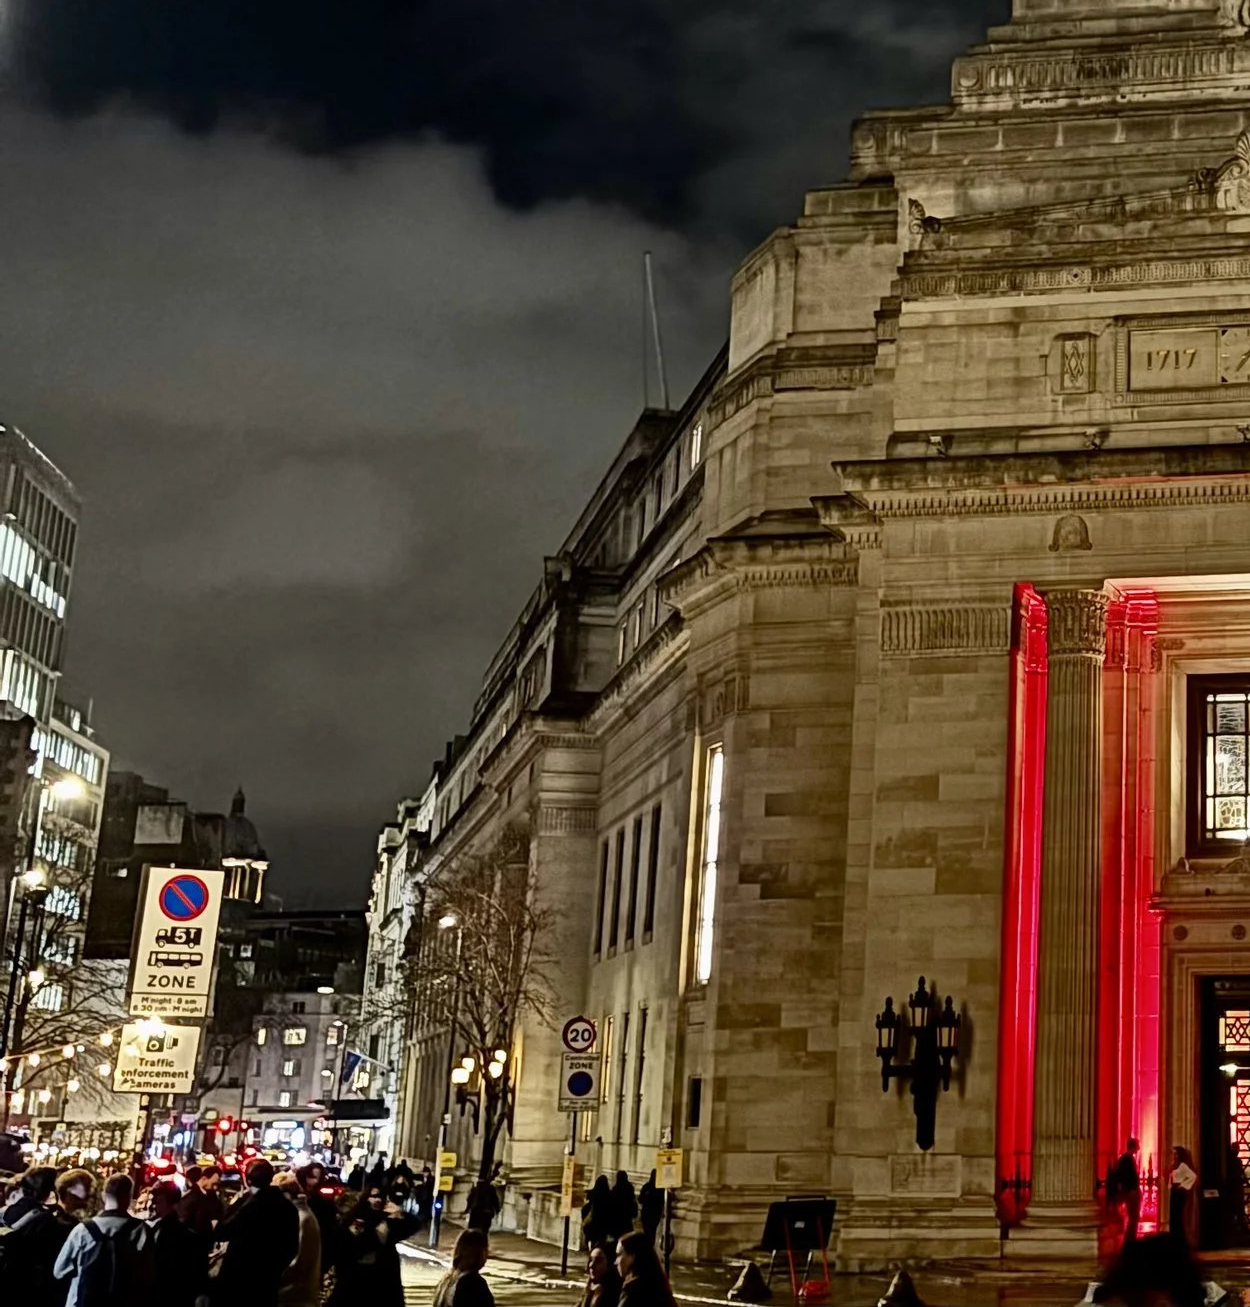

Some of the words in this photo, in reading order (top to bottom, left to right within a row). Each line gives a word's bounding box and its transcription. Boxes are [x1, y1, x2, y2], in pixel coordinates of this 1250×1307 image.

[1147, 349, 1197, 371] 1717
[174, 928, 197, 943] 5T
[147, 975, 196, 988] ZONE
[569, 1028, 592, 1042] 20
[139, 1058, 175, 1067] Traffic
[569, 1062, 593, 1070] ZONE
[121, 1069, 189, 1079] enforcement
